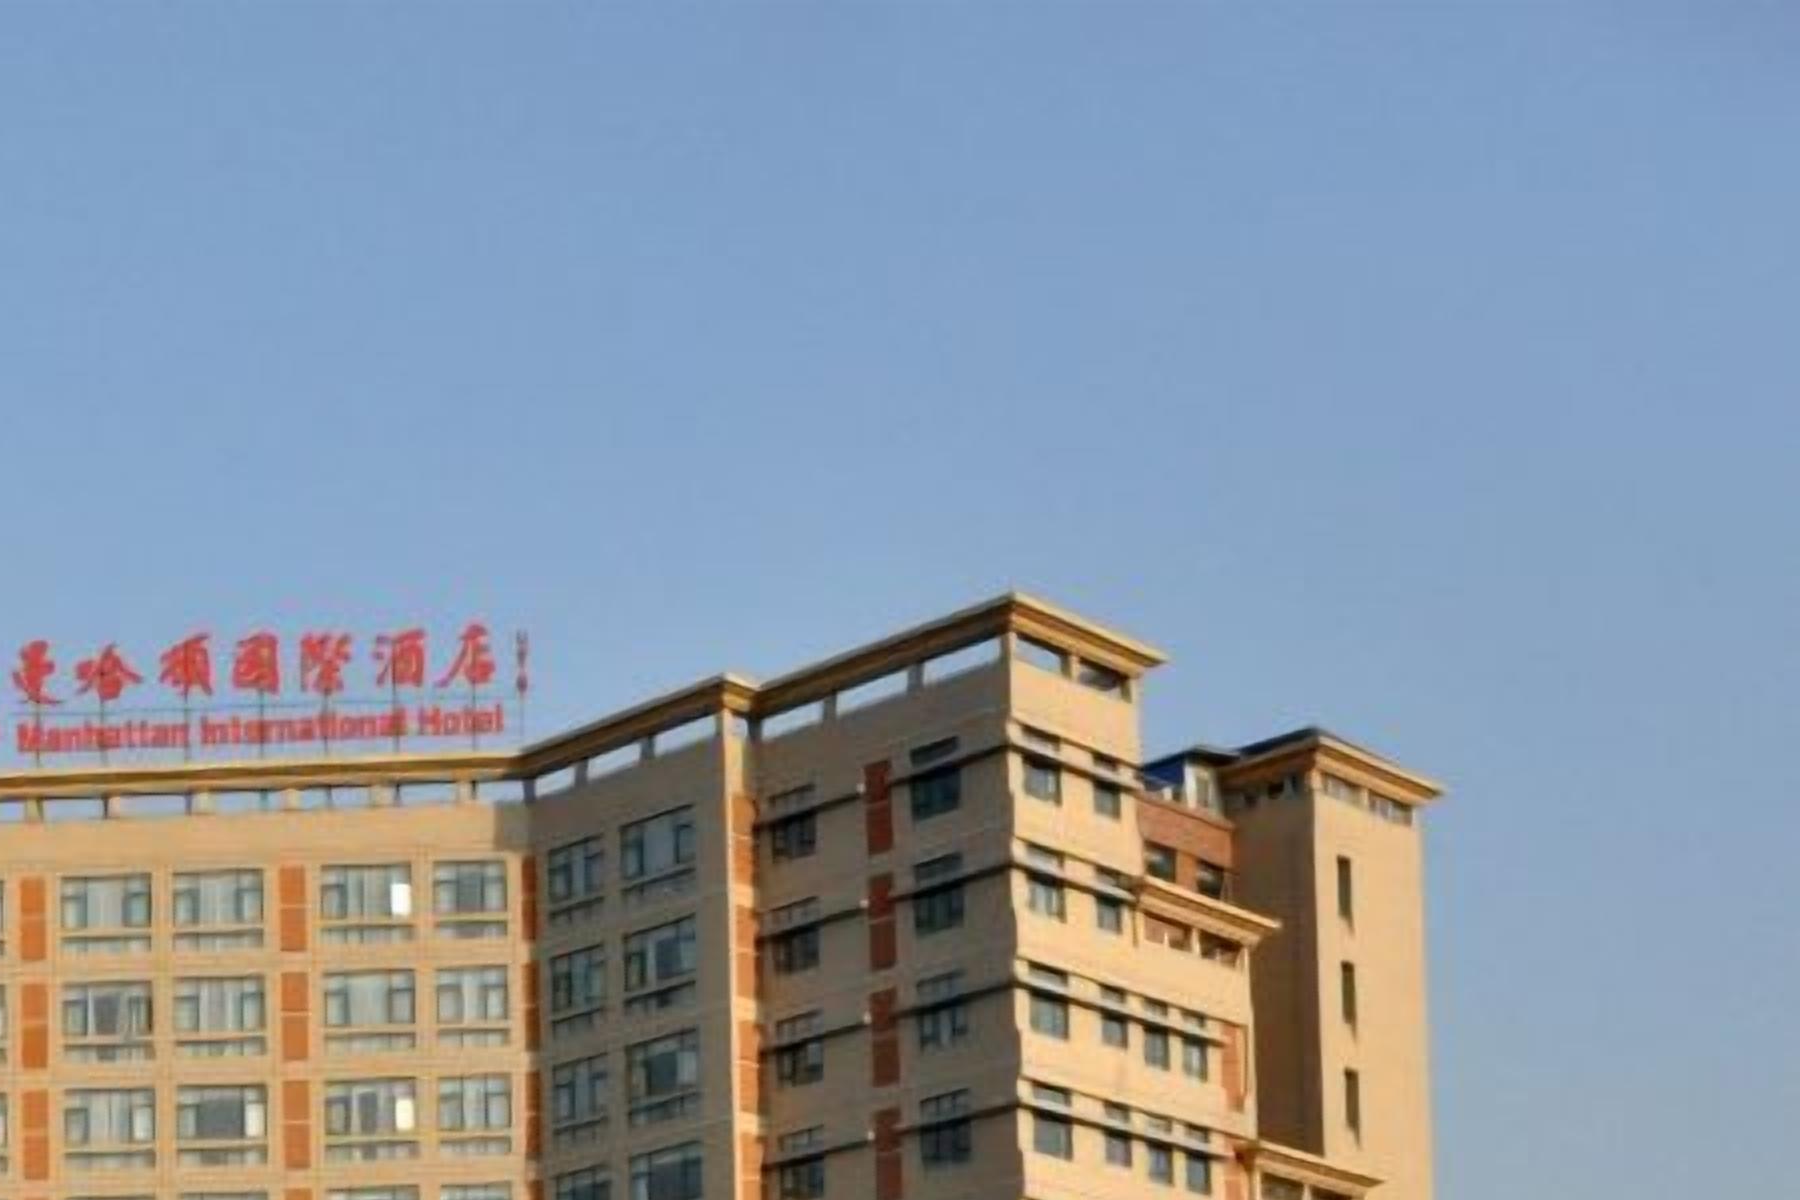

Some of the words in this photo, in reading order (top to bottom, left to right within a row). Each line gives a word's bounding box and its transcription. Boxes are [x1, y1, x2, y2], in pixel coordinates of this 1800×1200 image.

[15, 718, 191, 753] Manhattan
[200, 708, 409, 746] International
[416, 704, 505, 741] Hotel
